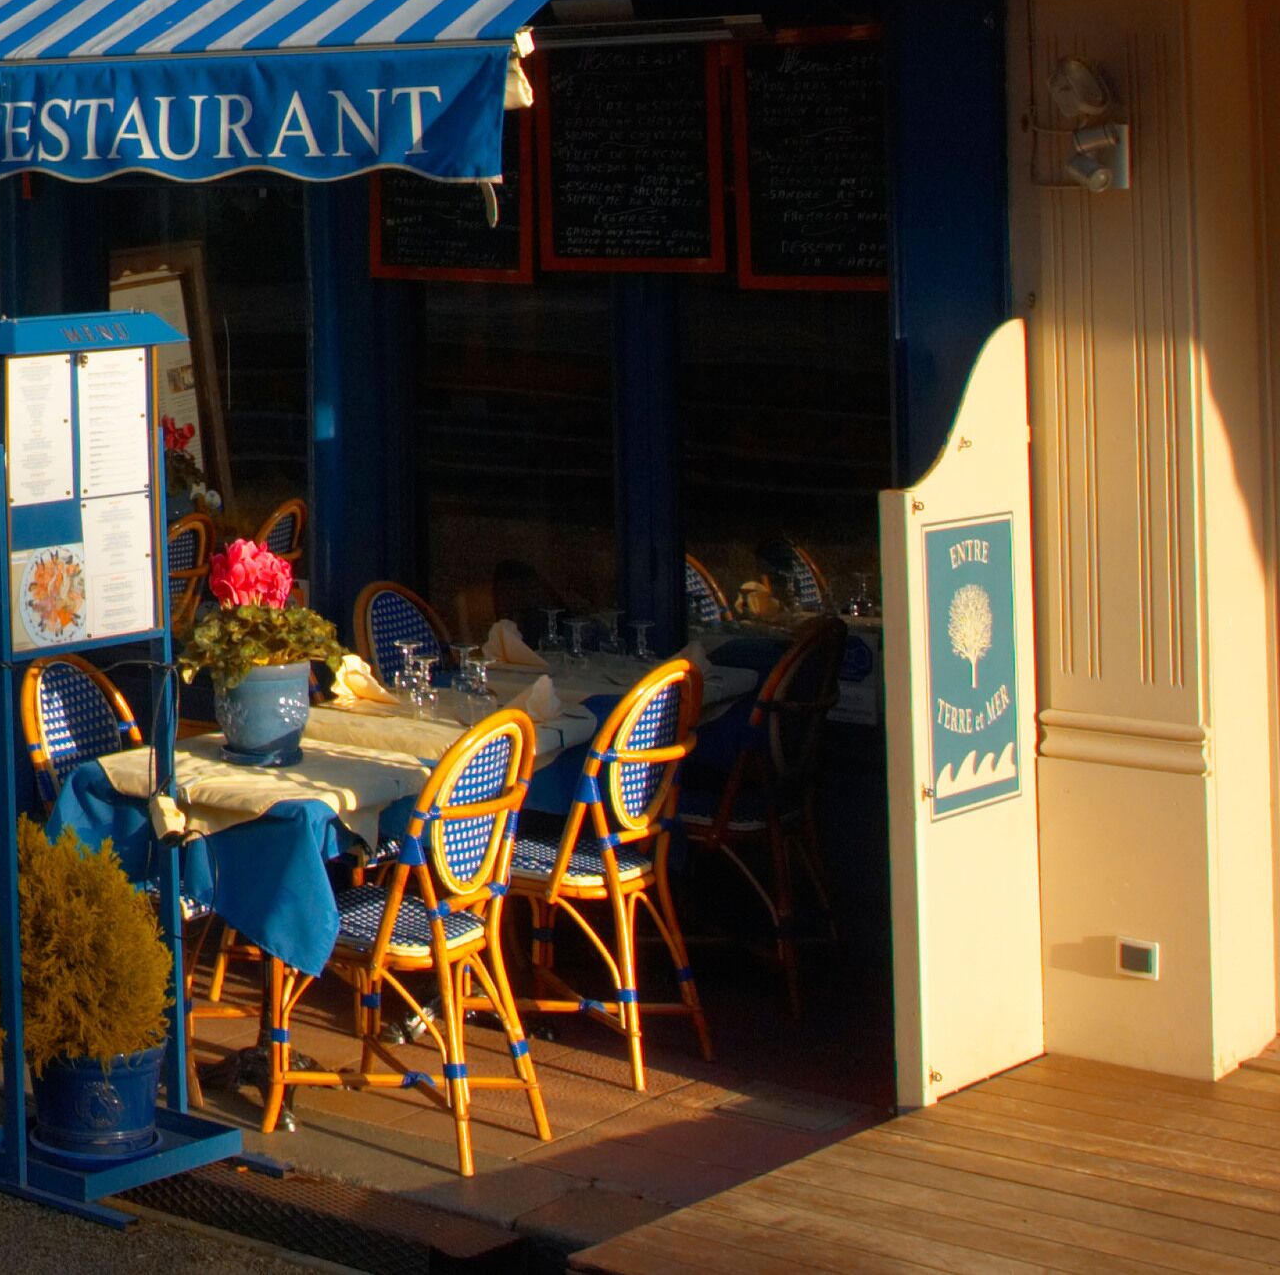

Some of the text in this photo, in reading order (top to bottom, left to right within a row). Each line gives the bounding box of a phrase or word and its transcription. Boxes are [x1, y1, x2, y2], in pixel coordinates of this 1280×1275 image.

[61, 322, 130, 343] MENU
[948, 538, 989, 570] ENTRE
[937, 684, 1011, 735] TERRE et MER
